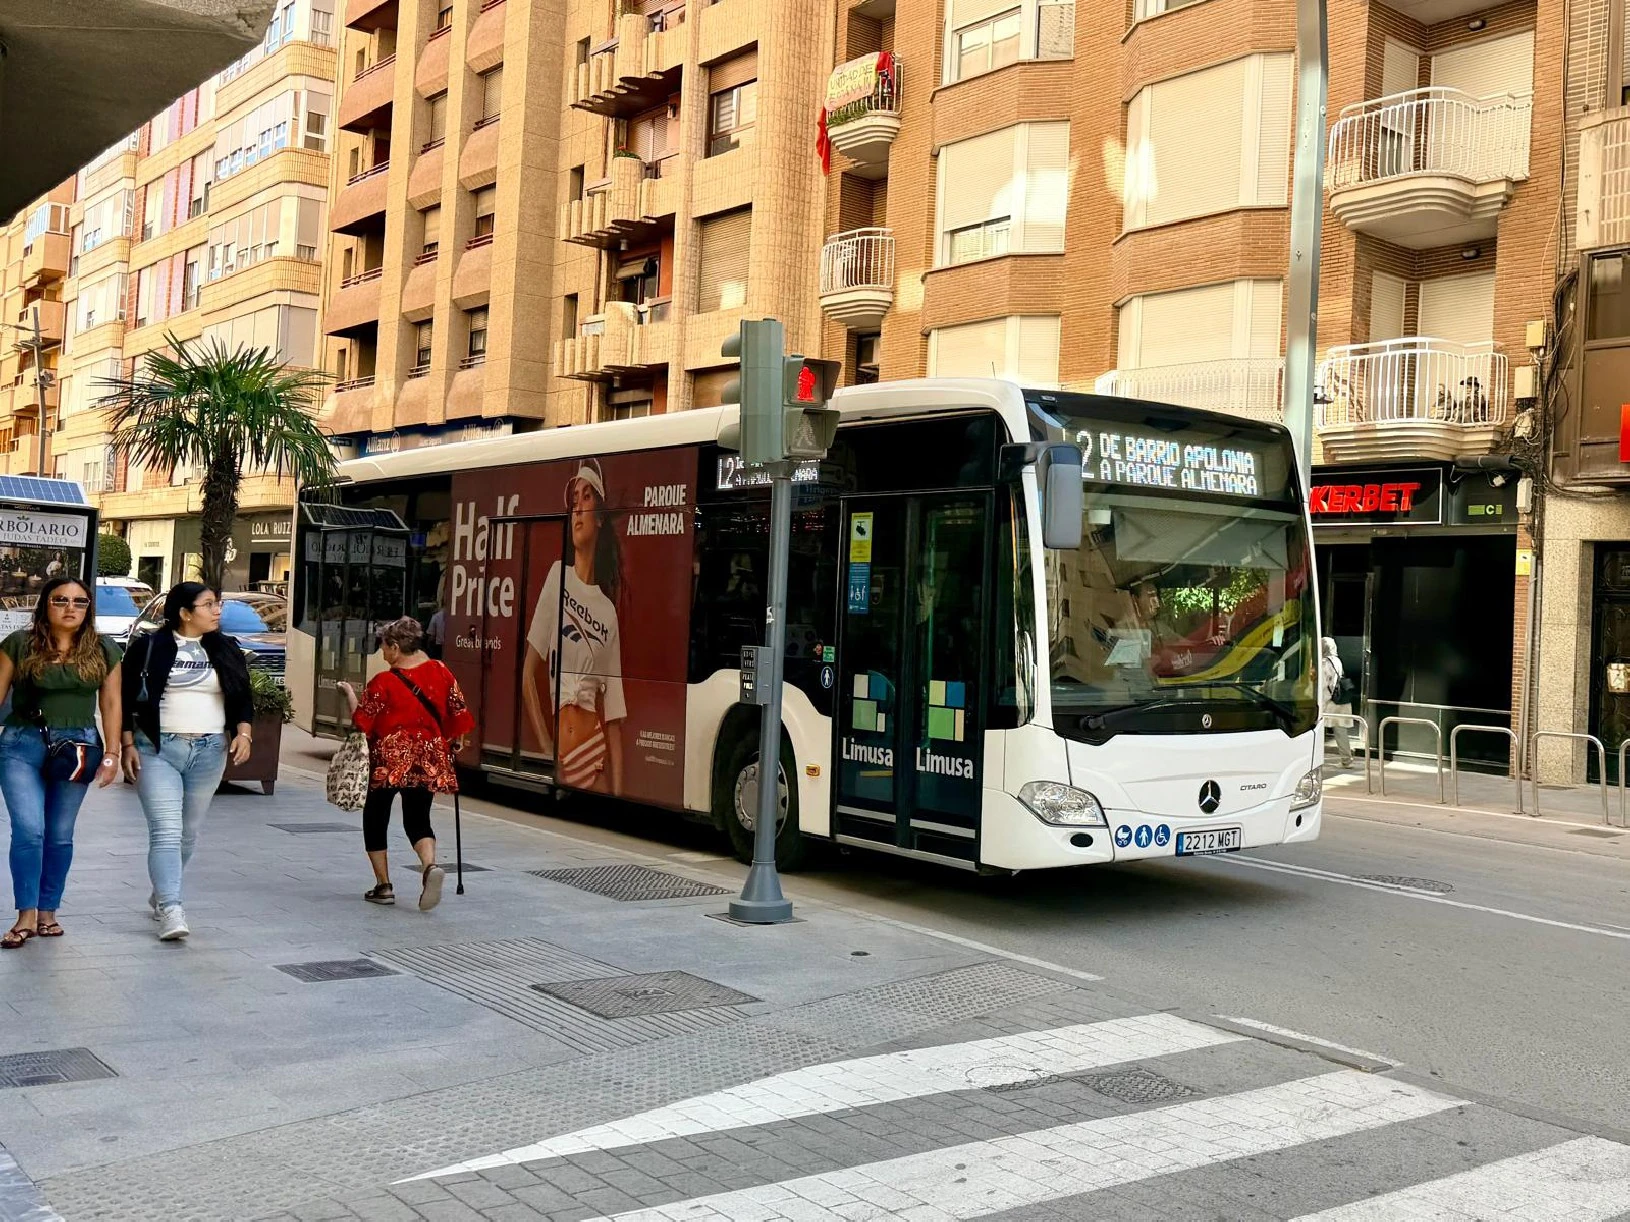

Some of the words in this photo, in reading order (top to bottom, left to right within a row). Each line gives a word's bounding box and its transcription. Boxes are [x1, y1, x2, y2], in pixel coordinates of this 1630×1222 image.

[365, 436, 391, 454] Allianz
[1099, 433, 1122, 460] DE
[1125, 436, 1180, 467] BARRIO
[1183, 445, 1255, 475] APOLONIA
[1099, 459, 1112, 481] A
[1115, 460, 1178, 487] PARQUE
[1181, 469, 1258, 496] ALMENARA
[643, 484, 687, 507] PARQUE
[1309, 482, 1422, 514] KERBET
[251, 522, 270, 535] LOLA
[273, 521, 292, 535] RUIZ
[453, 493, 519, 561] Half
[626, 512, 685, 536] ALMENARA
[451, 564, 515, 618] Price
[842, 736, 893, 767] Limusa
[916, 746, 974, 780] Limusa
[1240, 783, 1267, 791] CITARO
[1185, 833, 1215, 850] 2212
[1217, 830, 1237, 848] MGT
